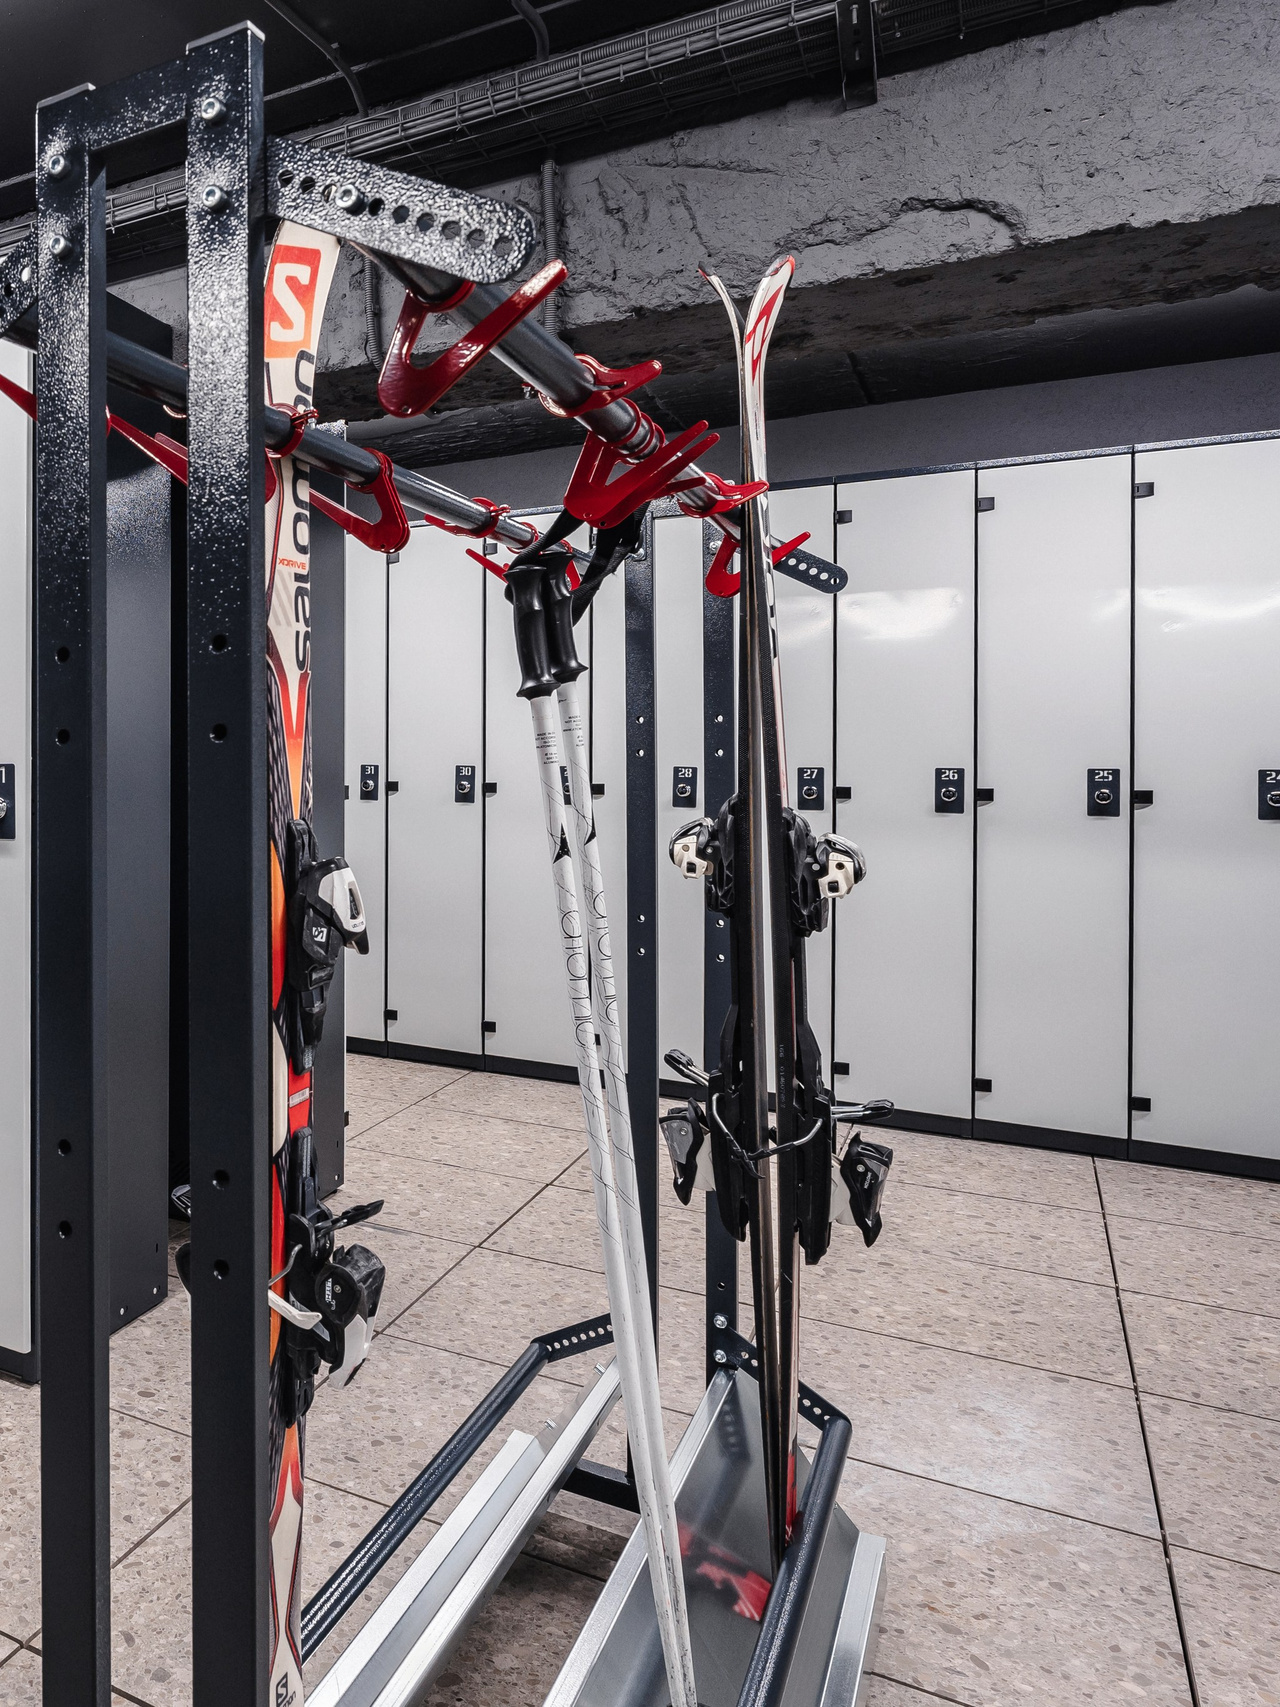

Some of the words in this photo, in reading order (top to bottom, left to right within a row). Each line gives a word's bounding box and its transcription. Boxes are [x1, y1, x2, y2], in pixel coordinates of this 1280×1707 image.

[270, 262, 311, 342] S
[278, 557, 307, 571] XDRIVE
[366, 766, 374, 774] 31
[459, 766, 472, 776] 30
[678, 768, 693, 778] 28
[804, 769, 817, 778] 27
[942, 770, 957, 779] 26
[1094, 770, 1113, 782] 25
